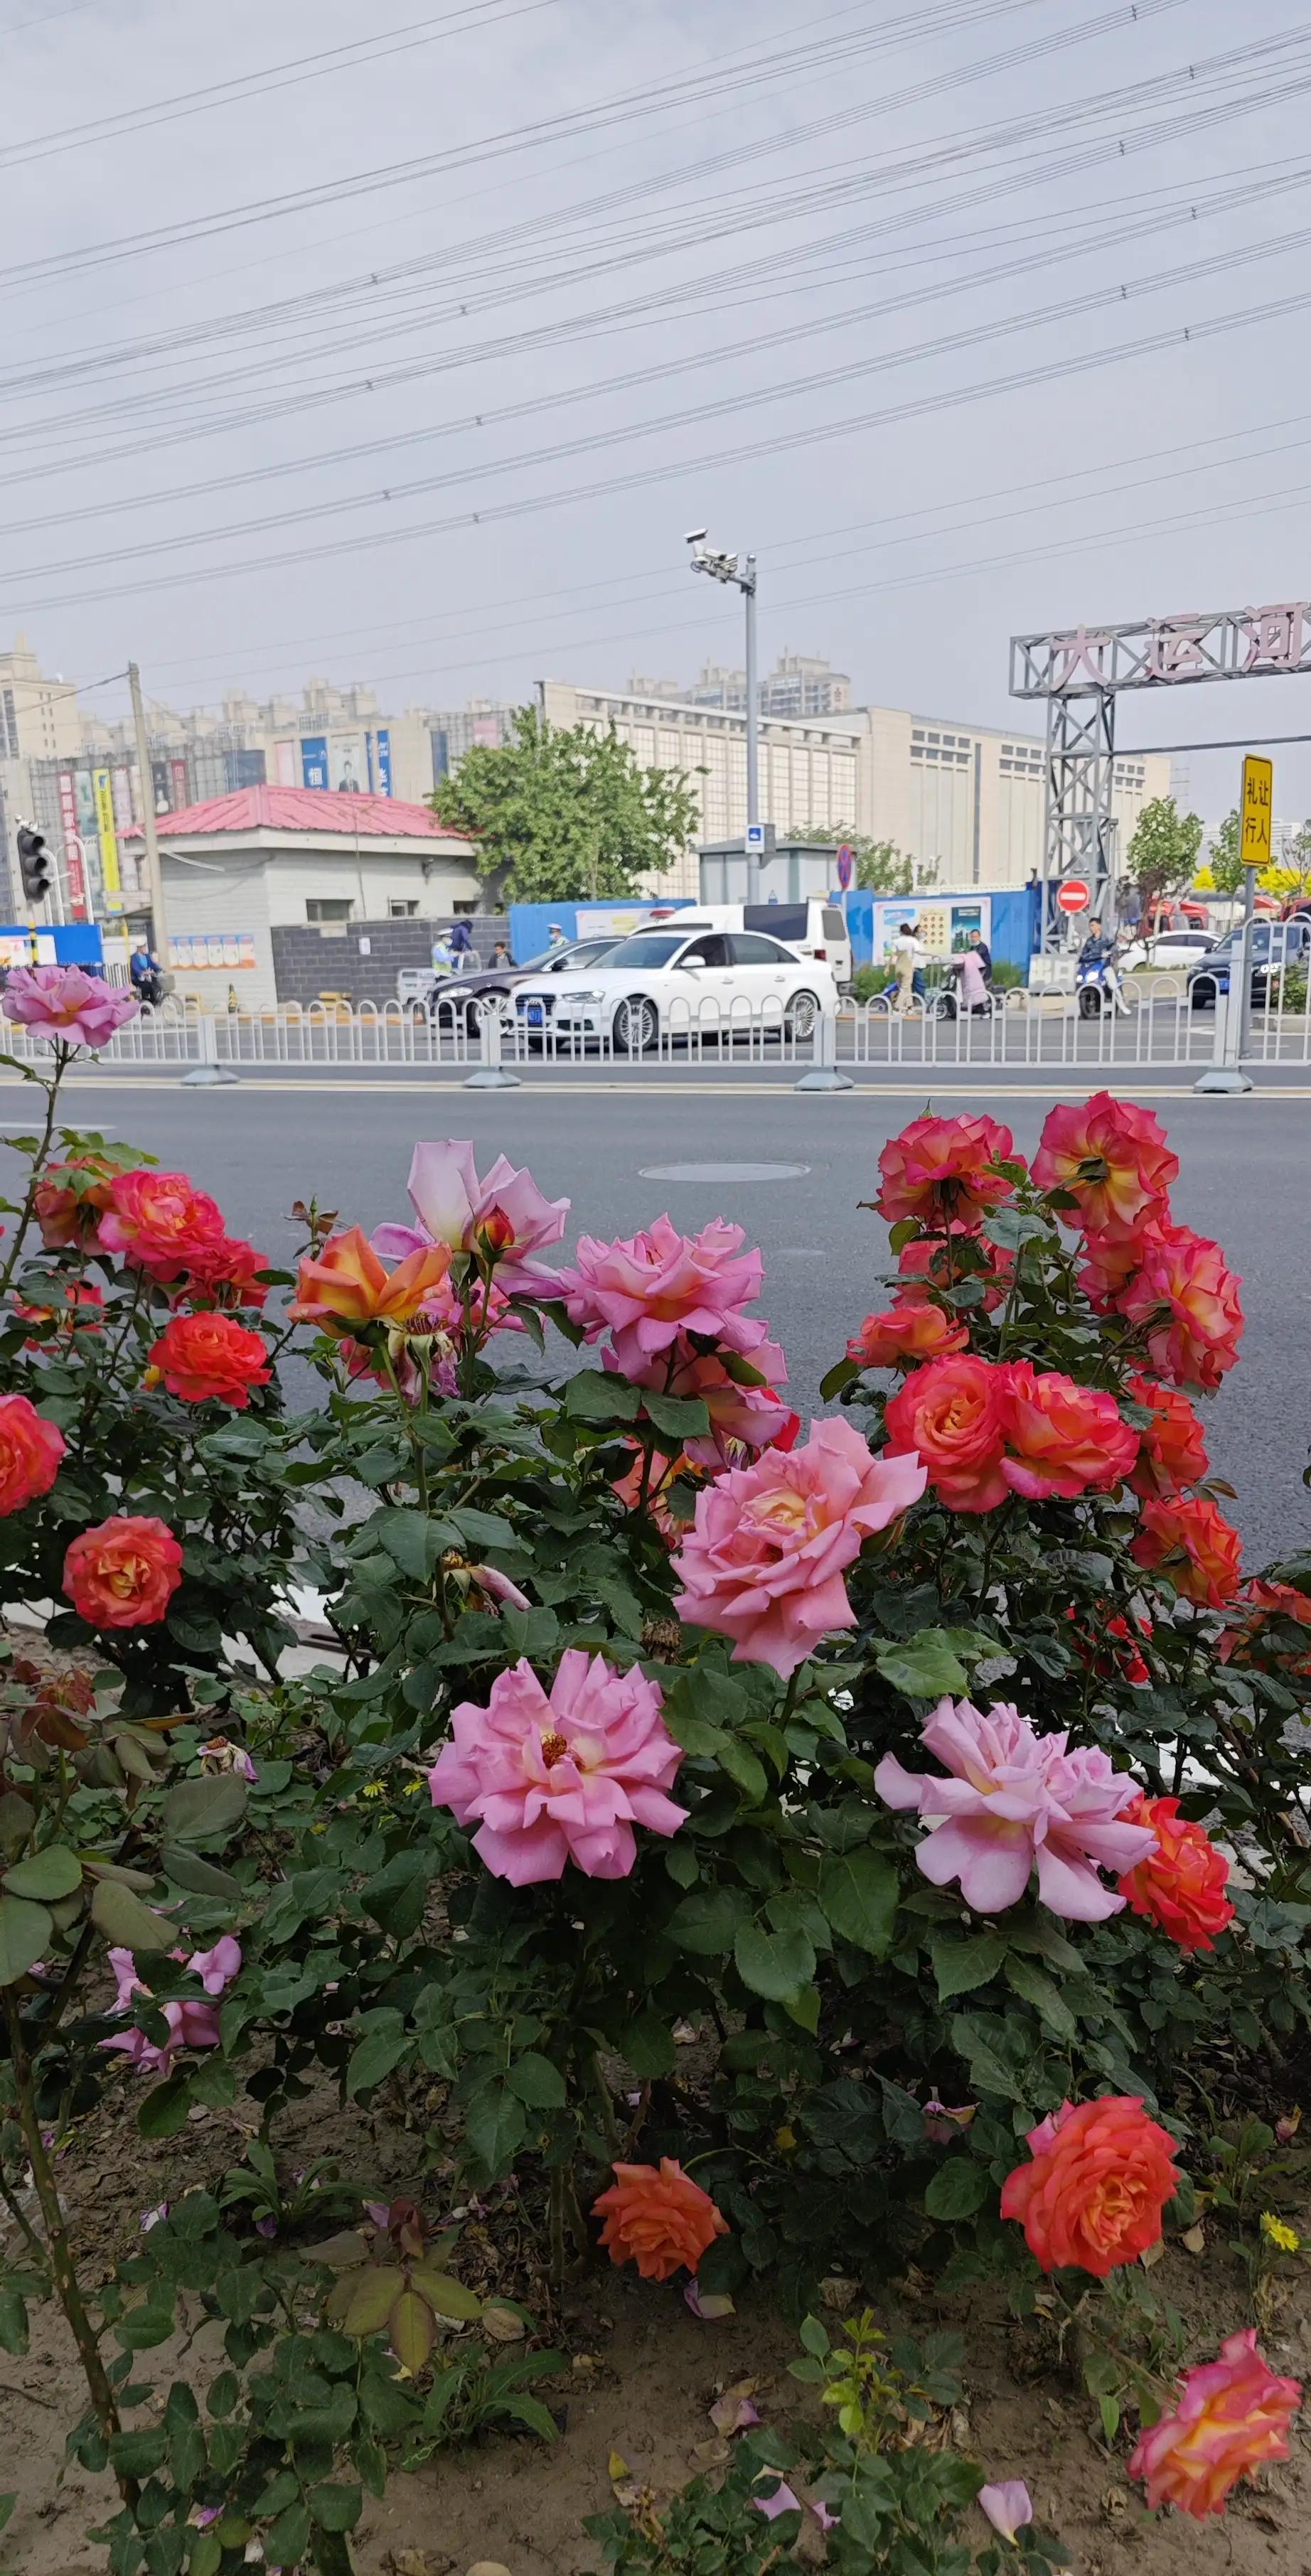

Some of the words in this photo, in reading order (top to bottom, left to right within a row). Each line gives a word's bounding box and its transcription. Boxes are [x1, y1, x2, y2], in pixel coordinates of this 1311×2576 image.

[1050, 601, 1310, 692] 大运河
[1247, 777, 1268, 806] 礼让
[1246, 817, 1268, 844] 行人
